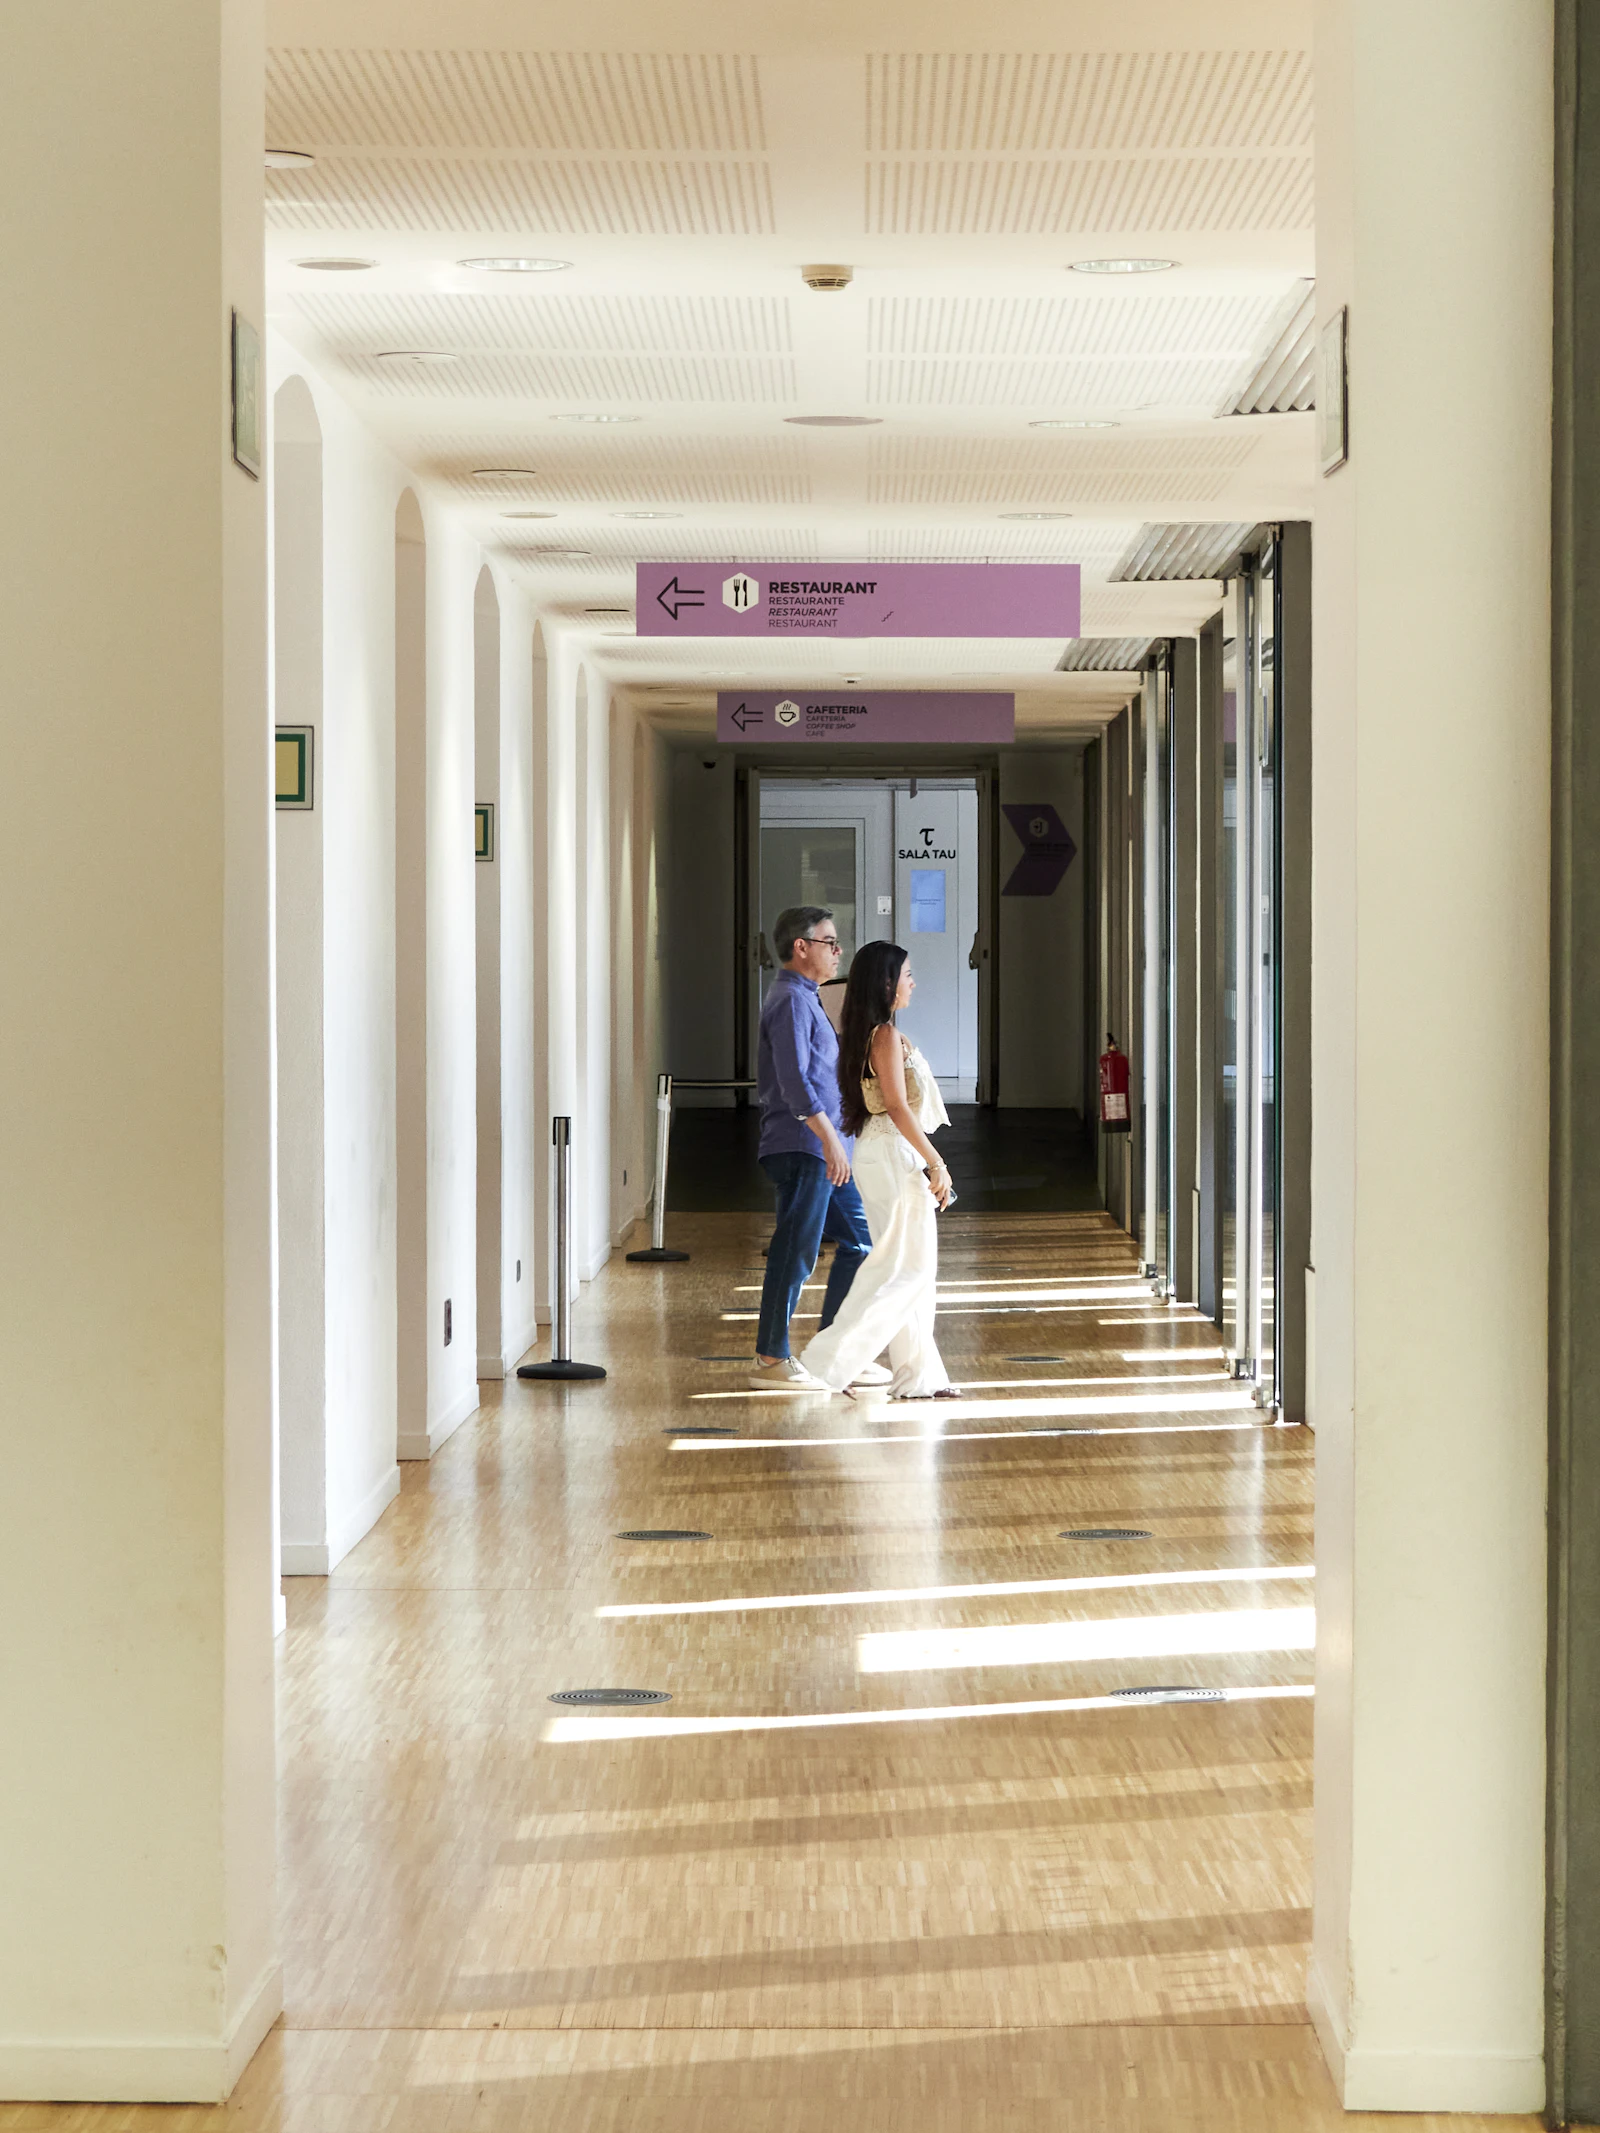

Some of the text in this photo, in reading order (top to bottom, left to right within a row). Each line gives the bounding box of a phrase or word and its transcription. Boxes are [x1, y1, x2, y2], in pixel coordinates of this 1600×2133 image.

[769, 582, 877, 594] RESTAURANT
[768, 597, 845, 605] RESTAURANTE
[768, 608, 838, 616] RESTAURANT
[768, 619, 838, 628] RESTAURANT
[806, 706, 867, 714] CAFETERIA
[898, 849, 956, 859] SALA TAU
